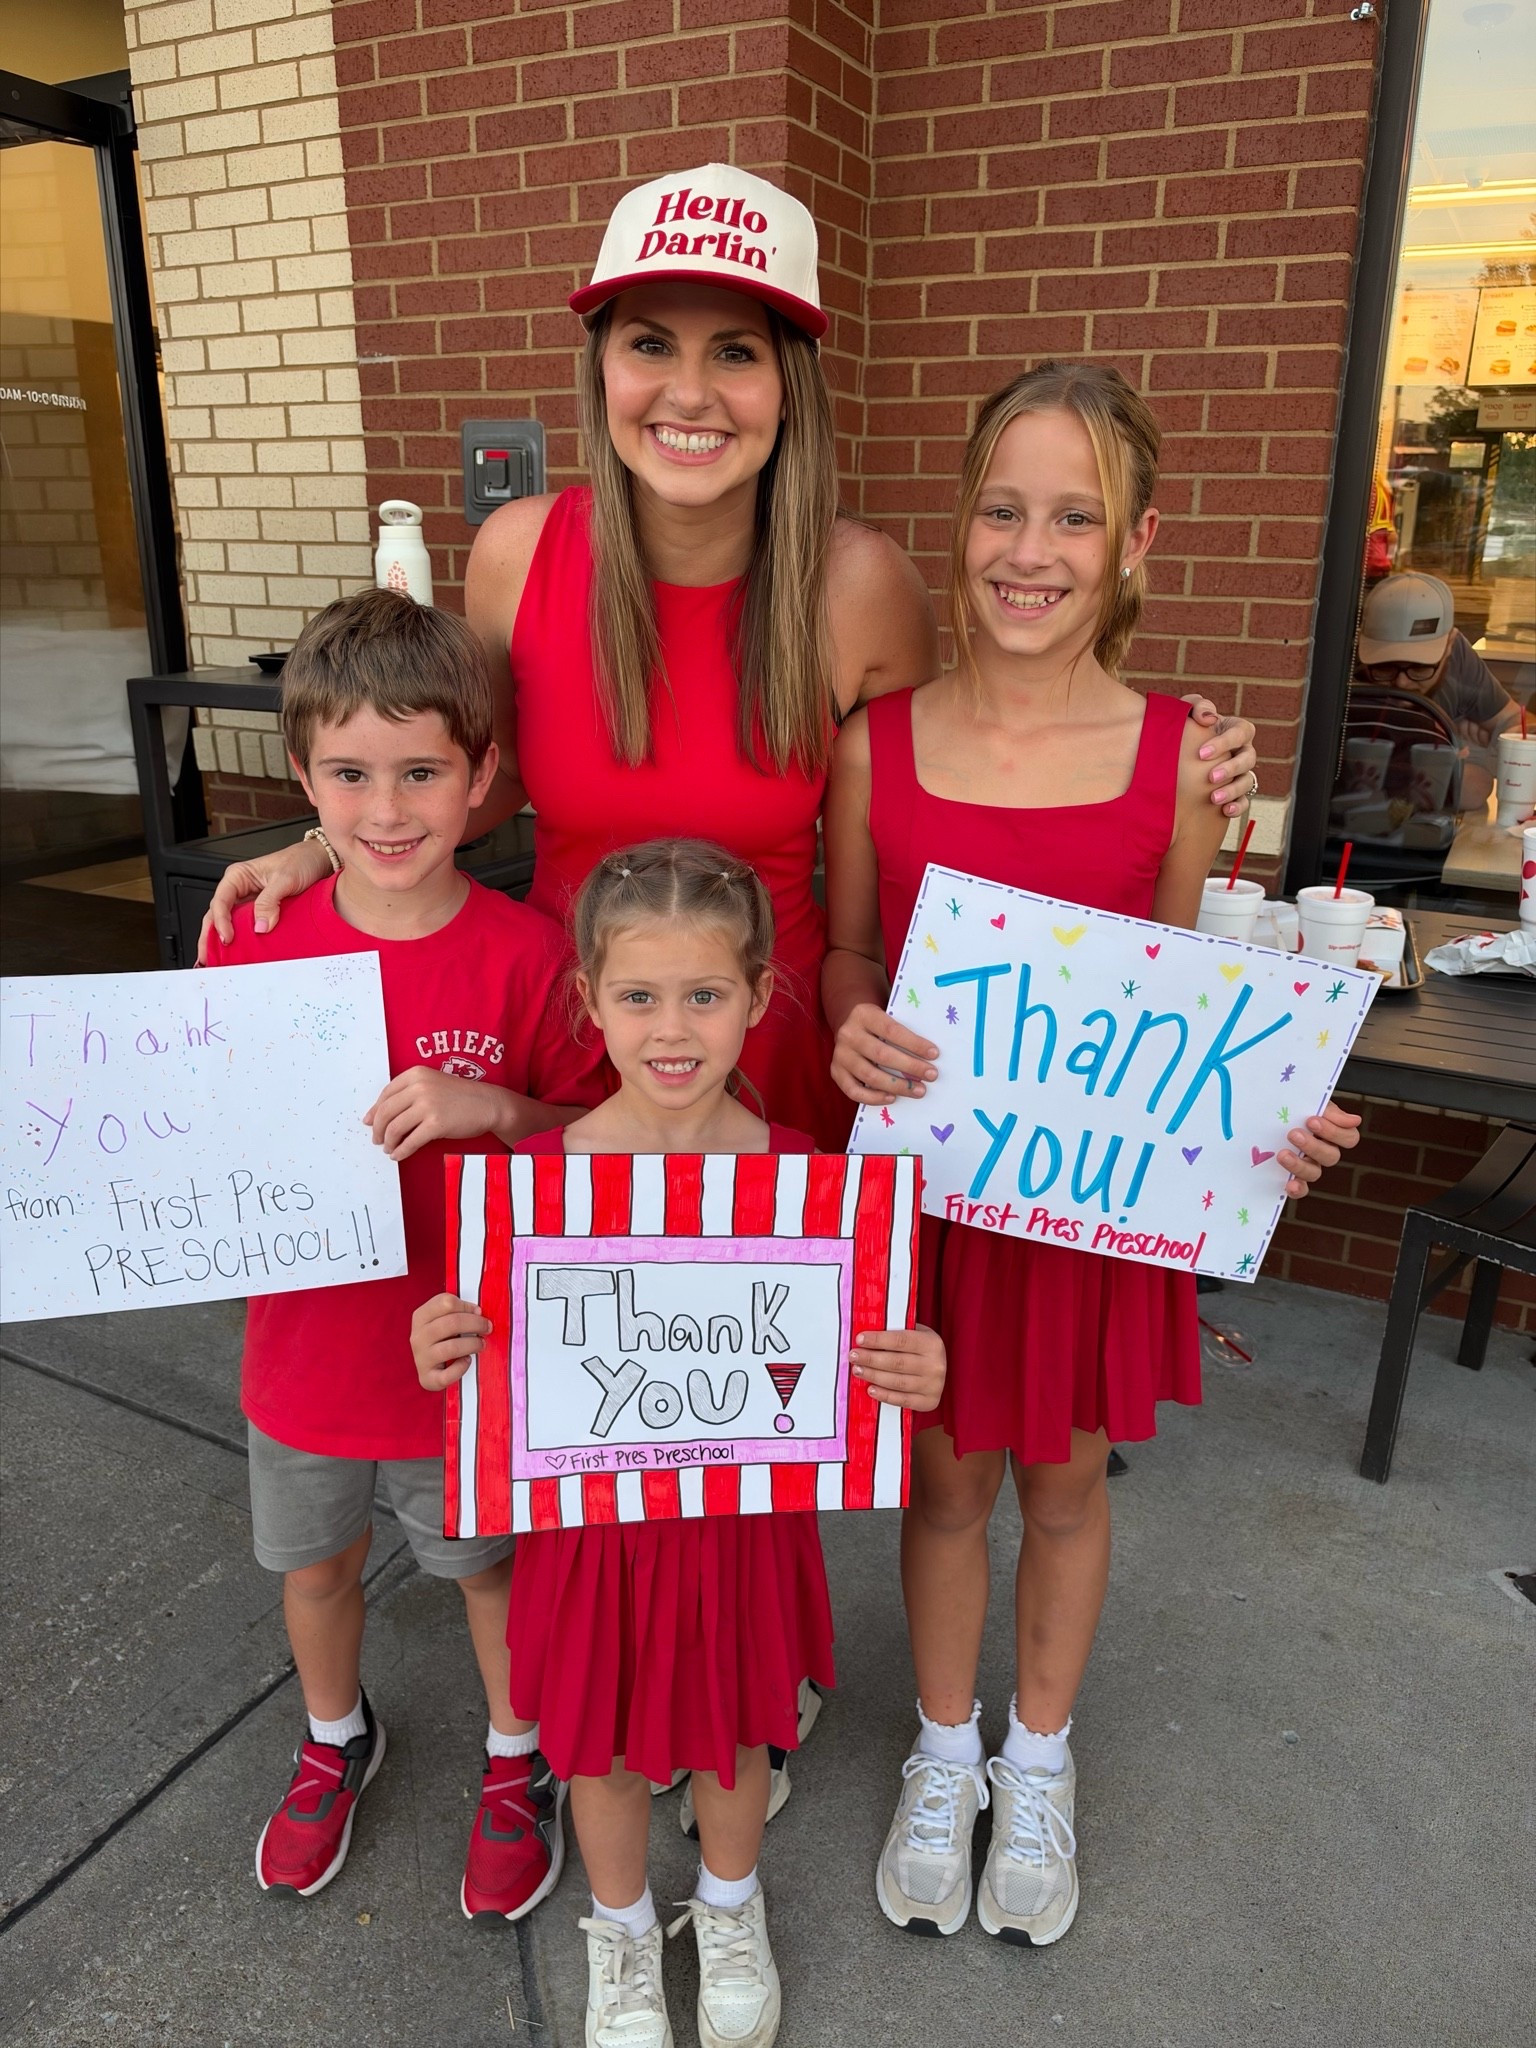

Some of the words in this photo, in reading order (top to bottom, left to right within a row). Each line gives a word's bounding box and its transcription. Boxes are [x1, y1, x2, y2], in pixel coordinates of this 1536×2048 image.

[652, 188, 768, 234] Hello
[635, 230, 777, 273] Darlin'
[9, 997, 227, 1068] Thank
[415, 1029, 505, 1065] CHIEFS
[109, 1178, 213, 1232] First
[228, 1169, 315, 1224] Pres
[84, 1204, 381, 1297] PRESCHOOL!!
[944, 1192, 1021, 1232] First
[1025, 1206, 1085, 1243] Pres
[1090, 1222, 1207, 1270] Preschool
[569, 1450, 609, 1470] First
[615, 1449, 648, 1466] Pres
[653, 1444, 735, 1465] Preschool
